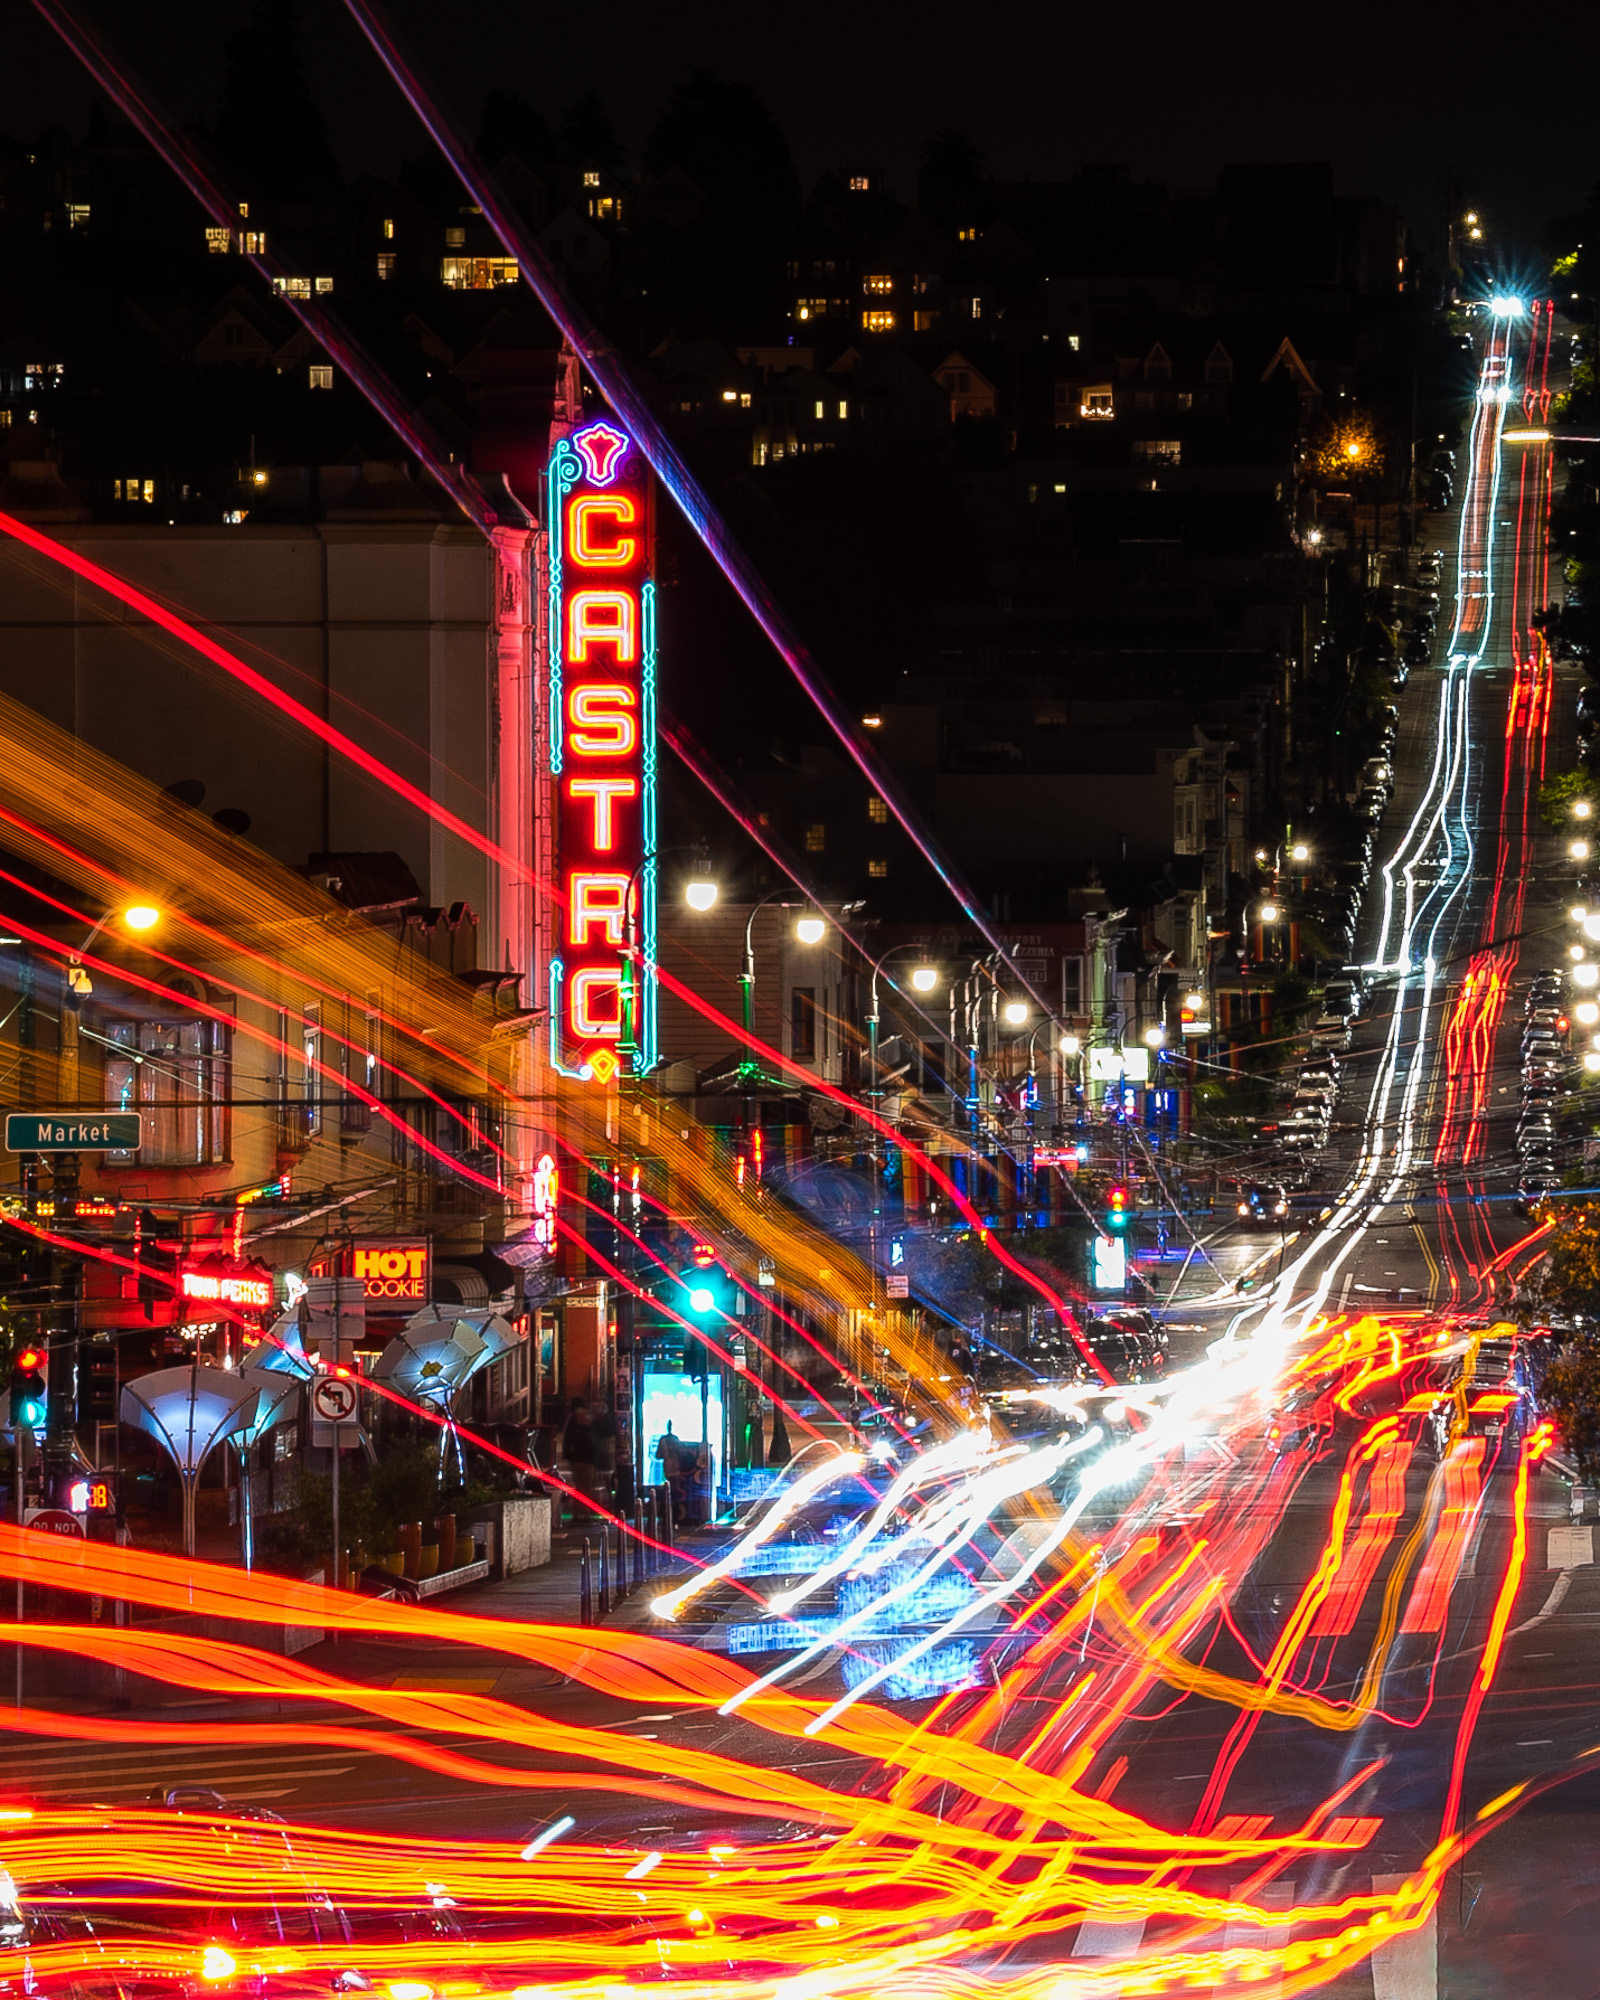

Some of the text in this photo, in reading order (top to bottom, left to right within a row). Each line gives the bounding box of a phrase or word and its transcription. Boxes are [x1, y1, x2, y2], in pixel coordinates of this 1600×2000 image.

[568, 494, 636, 1039] CASTRO
[38, 1123, 110, 1142] Market
[354, 1250, 427, 1279] HOT
[220, 1279, 270, 1305] PEAKS
[54, 1523, 76, 1533] NOT
